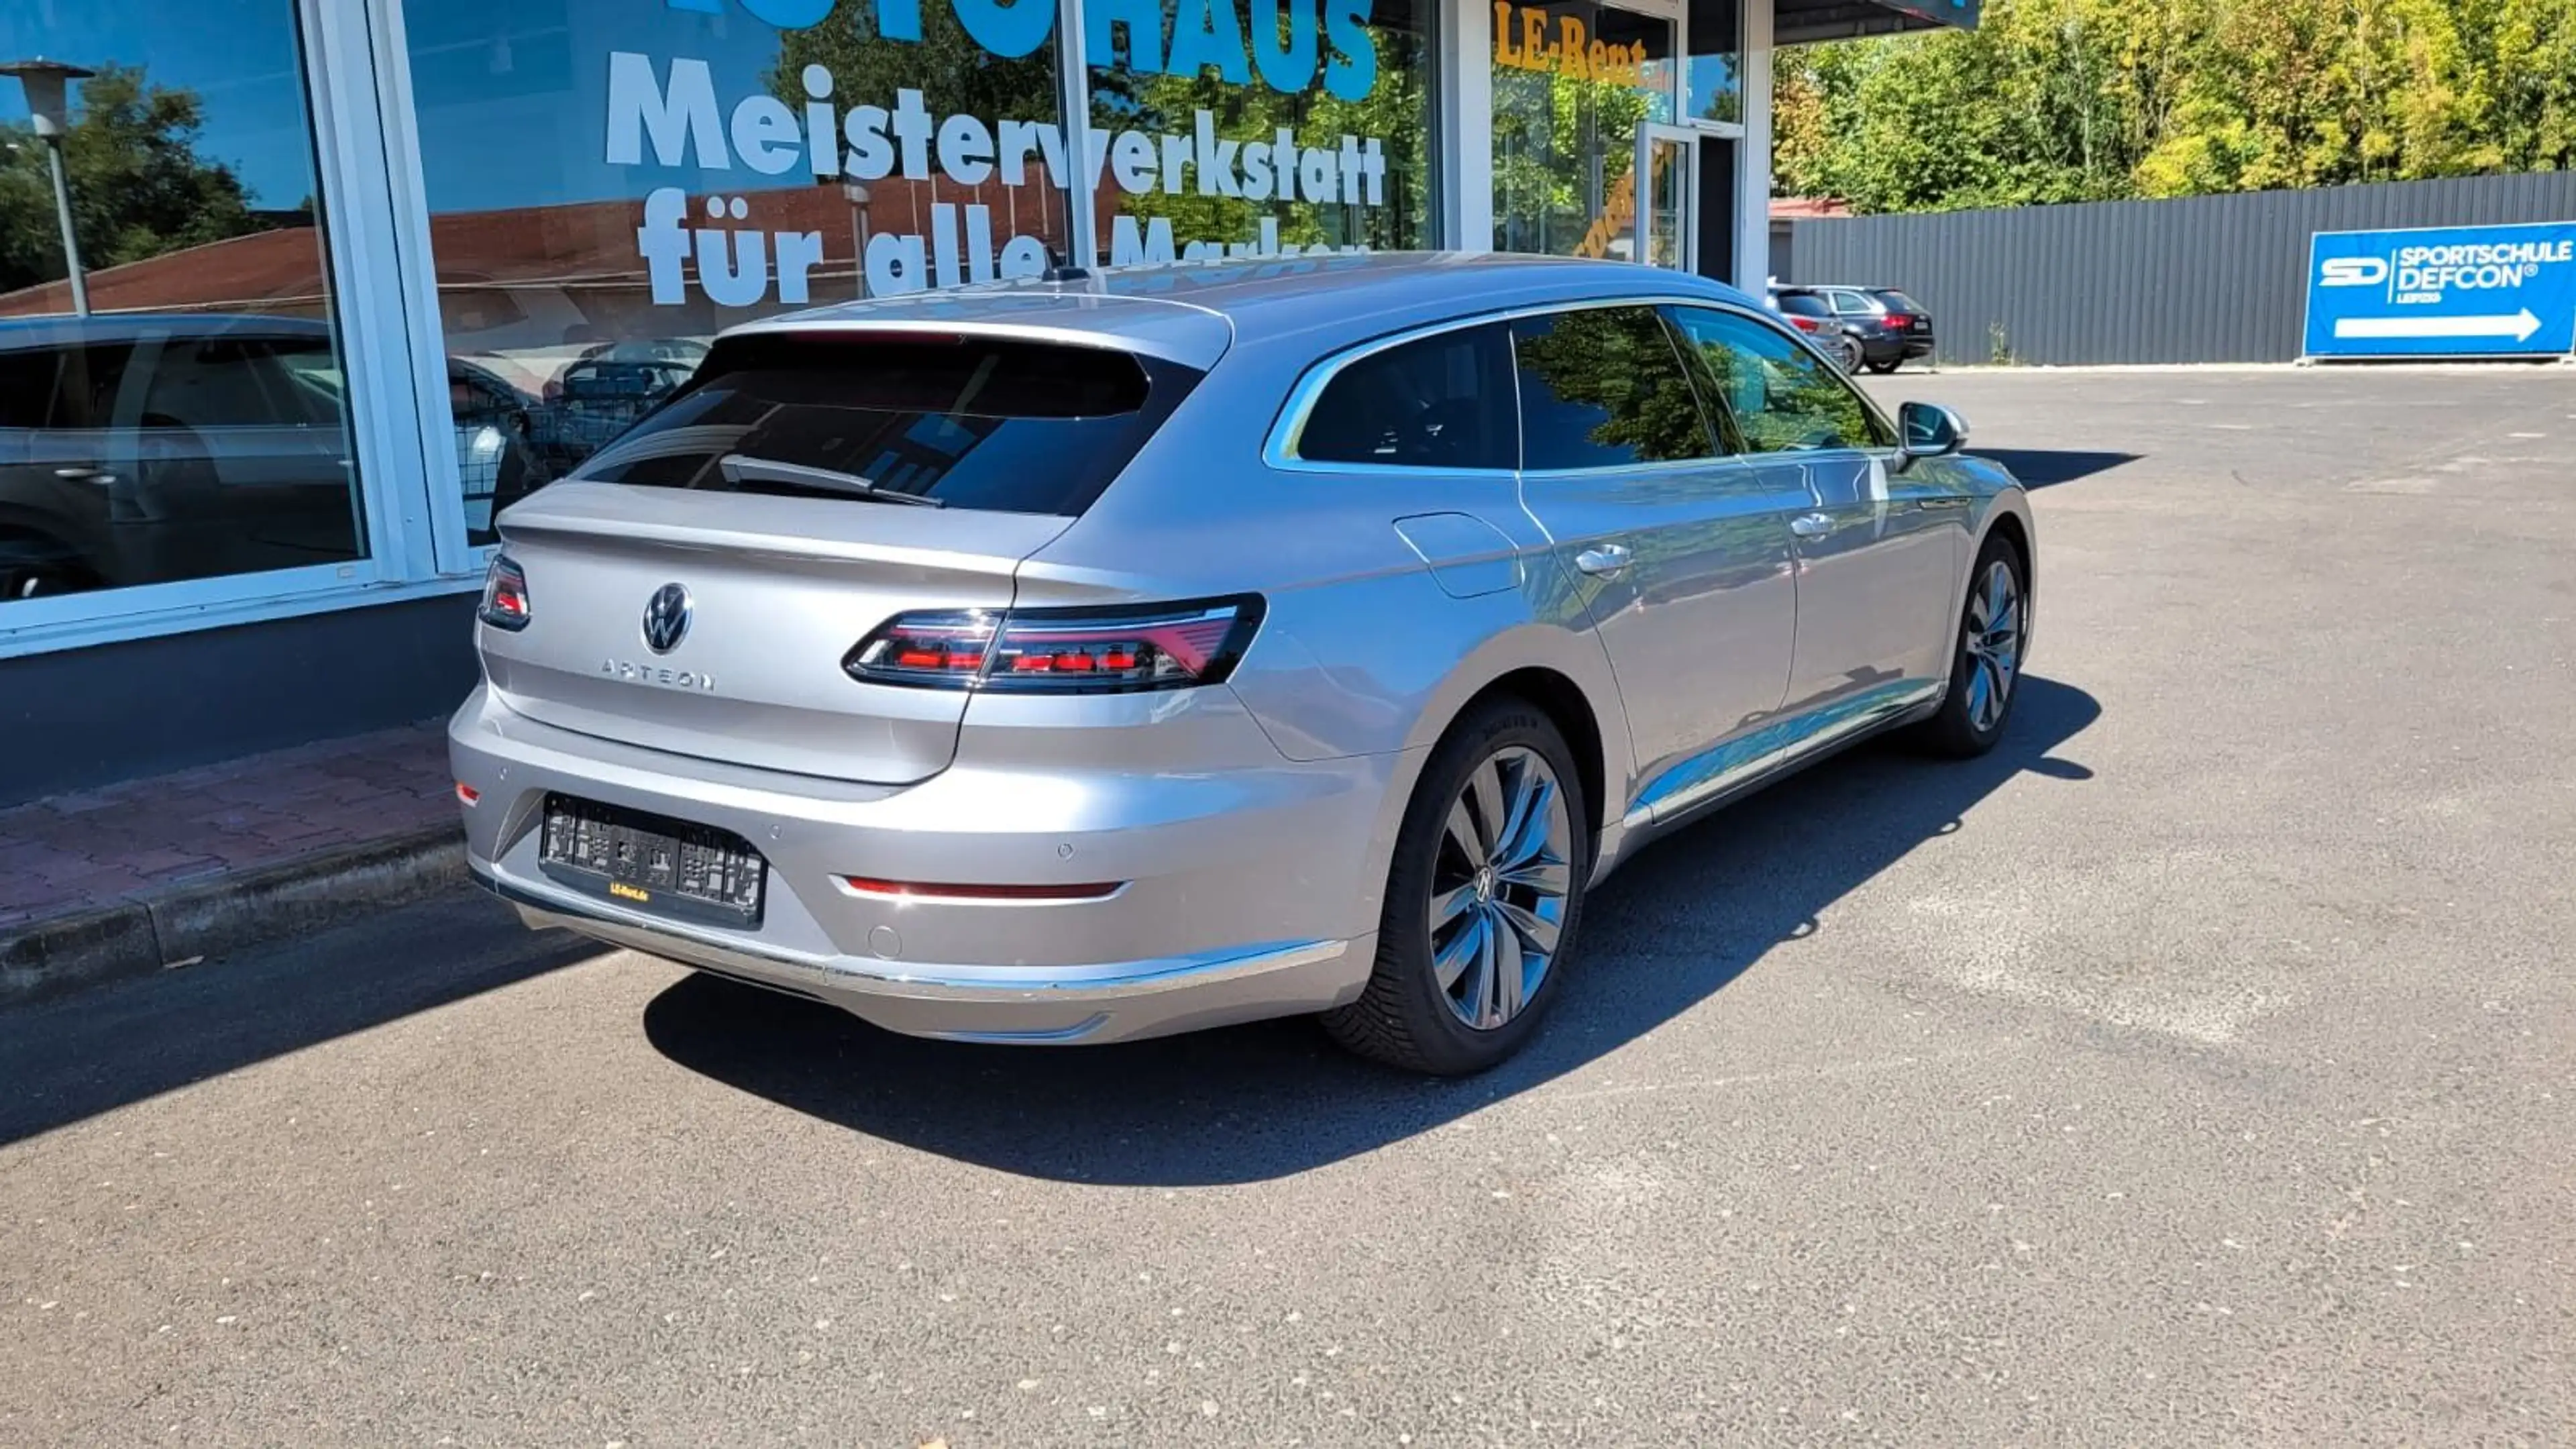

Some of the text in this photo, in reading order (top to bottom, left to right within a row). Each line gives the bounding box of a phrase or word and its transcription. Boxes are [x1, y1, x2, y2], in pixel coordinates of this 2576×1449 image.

[1494, 1, 1646, 87] LE-Rent
[637, 188, 824, 307] für
[865, 203, 1051, 297] alle
[2398, 241, 2574, 266] SPORTSCHULE
[602, 658, 715, 692] ARTEON
